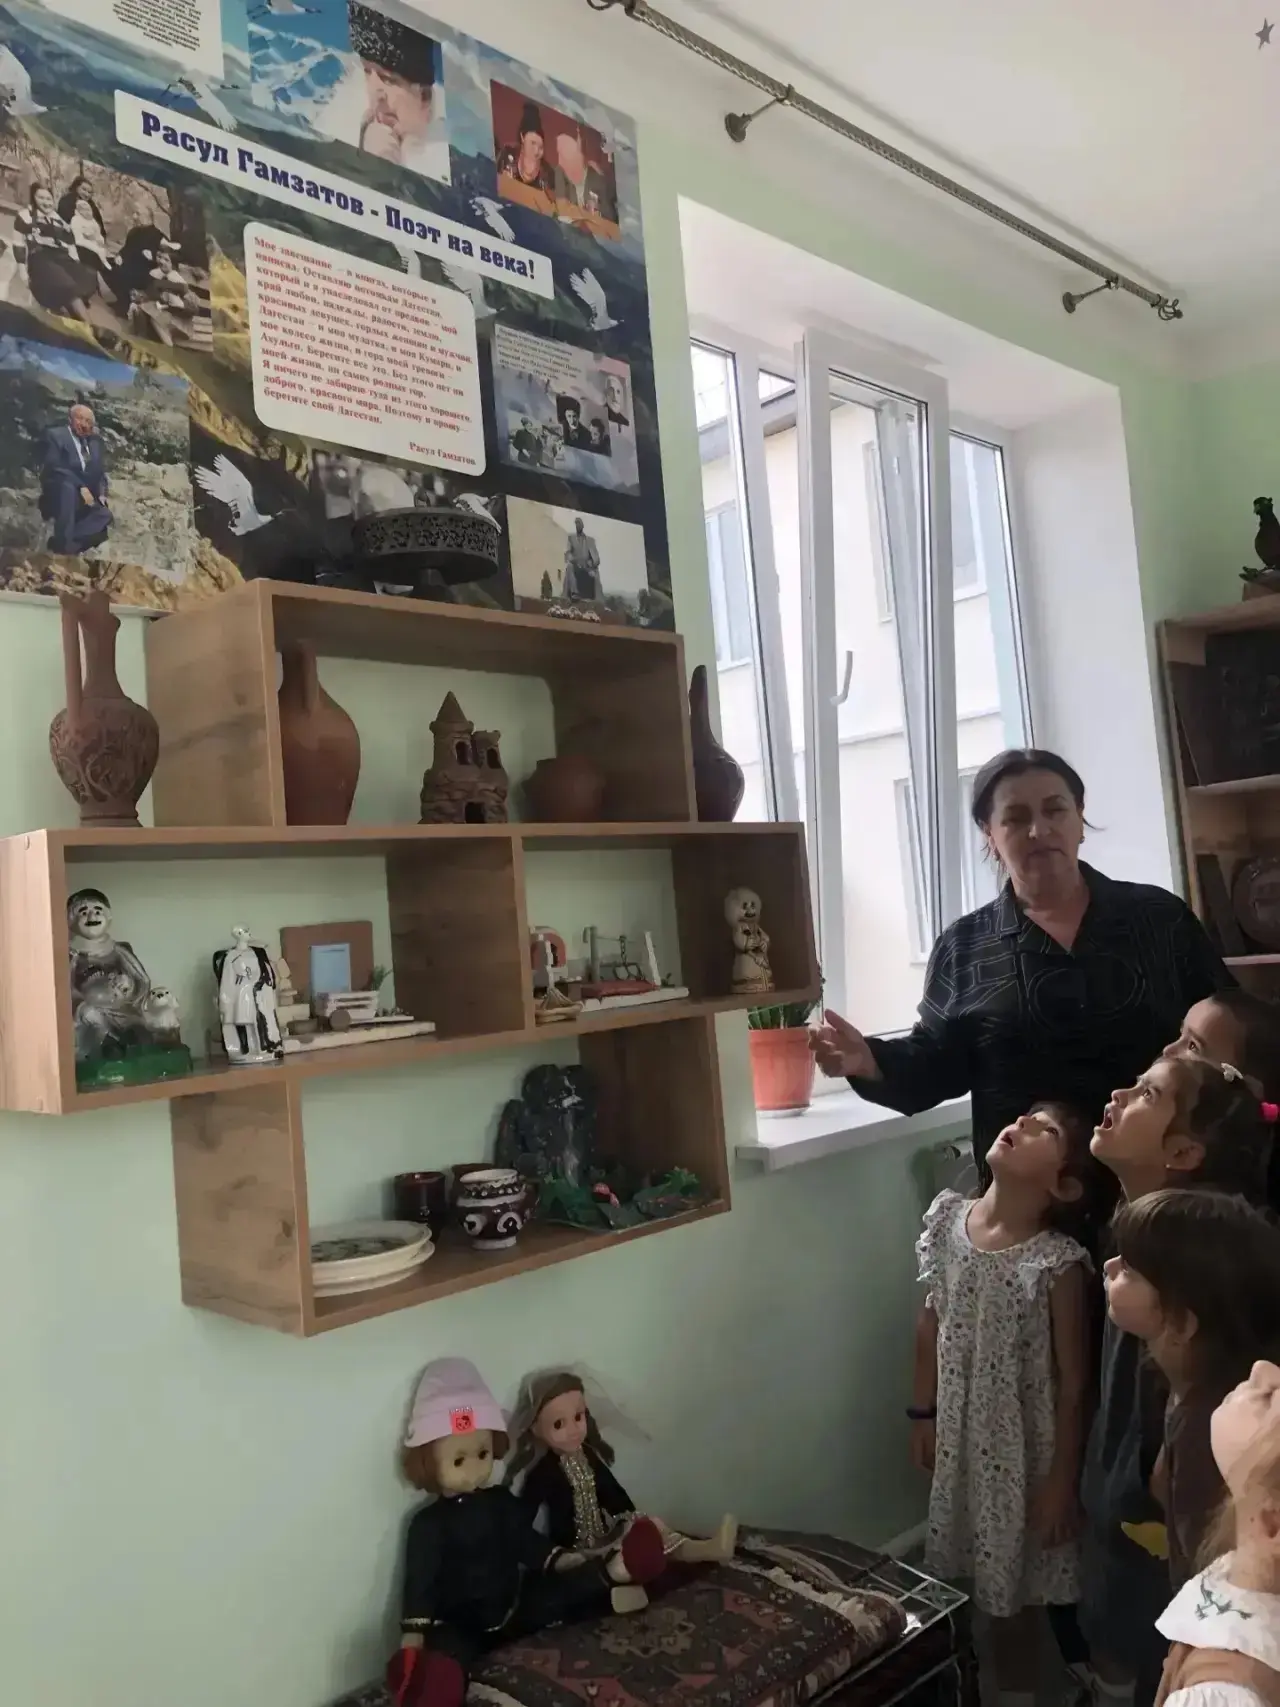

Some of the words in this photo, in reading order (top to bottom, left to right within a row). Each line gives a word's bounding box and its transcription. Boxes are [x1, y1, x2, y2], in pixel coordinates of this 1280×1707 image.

[141, 110, 229, 166] Расул
[237, 147, 364, 217] Гамзатов
[385, 204, 441, 244] Поэт
[447, 233, 475, 258] на
[479, 245, 535, 279] века!
[257, 265, 300, 285] который
[258, 278, 281, 293] край
[259, 293, 306, 313] красивых
[260, 305, 304, 324] Дагестан
[283, 327, 315, 341] колесо
[308, 346, 352, 365] Берегите
[274, 364, 308, 378] ничего
[264, 386, 308, 406] берегите
[312, 399, 334, 410] свой
[410, 442, 434, 455] Расул
